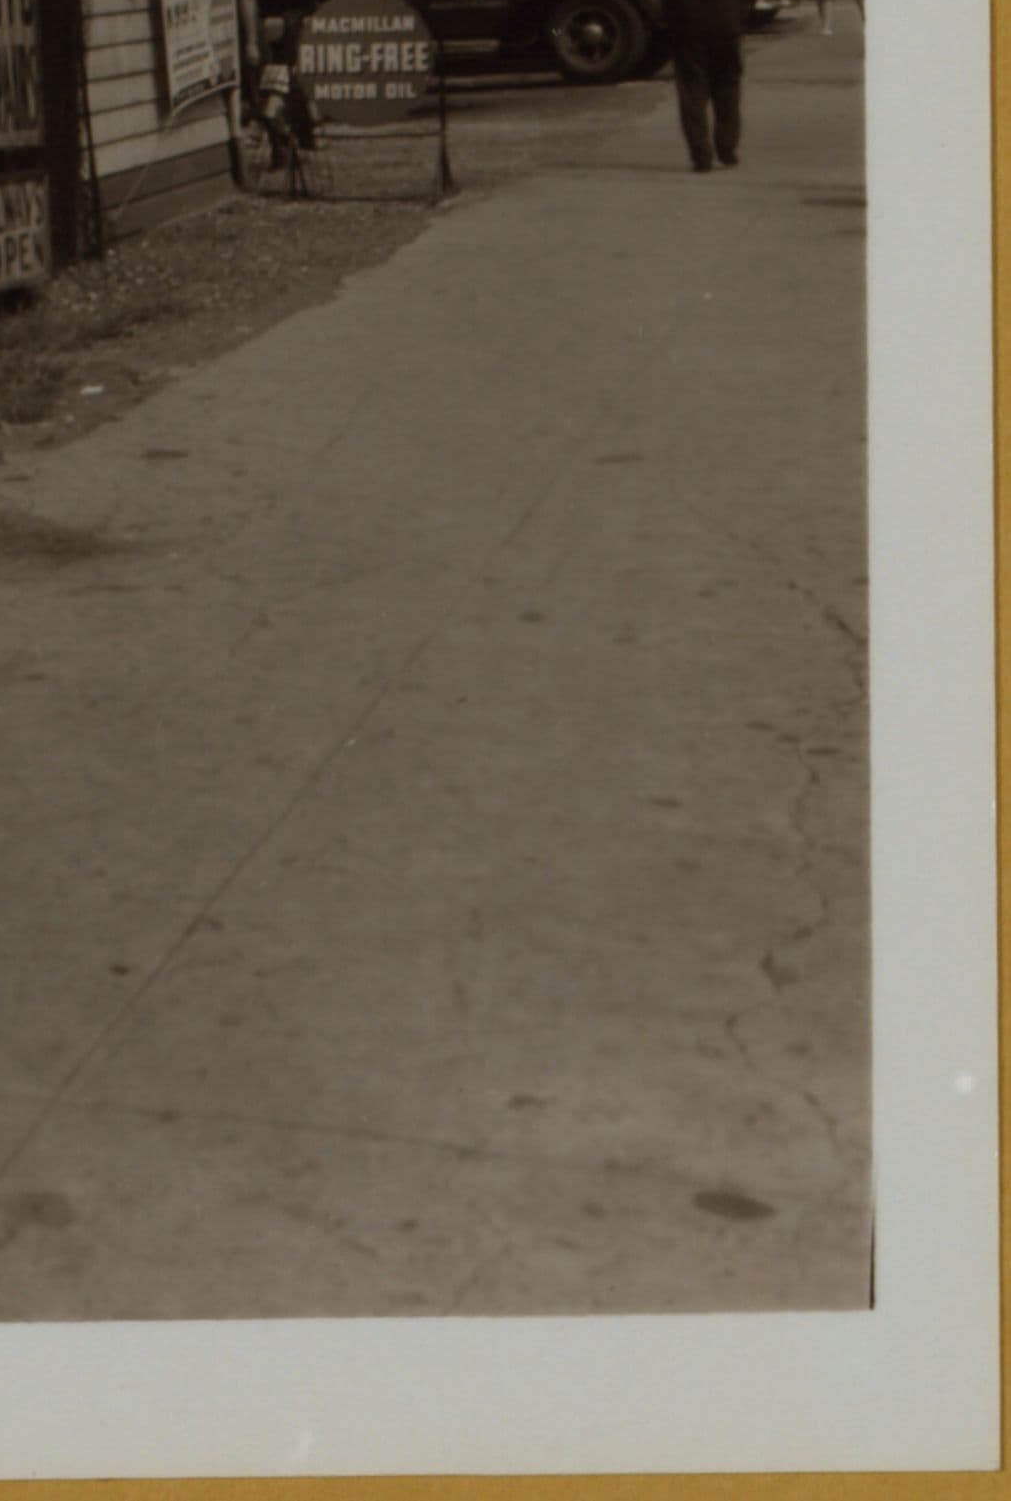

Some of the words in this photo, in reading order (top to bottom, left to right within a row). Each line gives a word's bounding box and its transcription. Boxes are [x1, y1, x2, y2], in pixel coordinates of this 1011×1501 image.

[311, 15, 416, 34] MACMILLAN
[298, 41, 430, 75] RING-FREE
[313, 82, 378, 101] MOTOR
[384, 81, 418, 99] OIL
